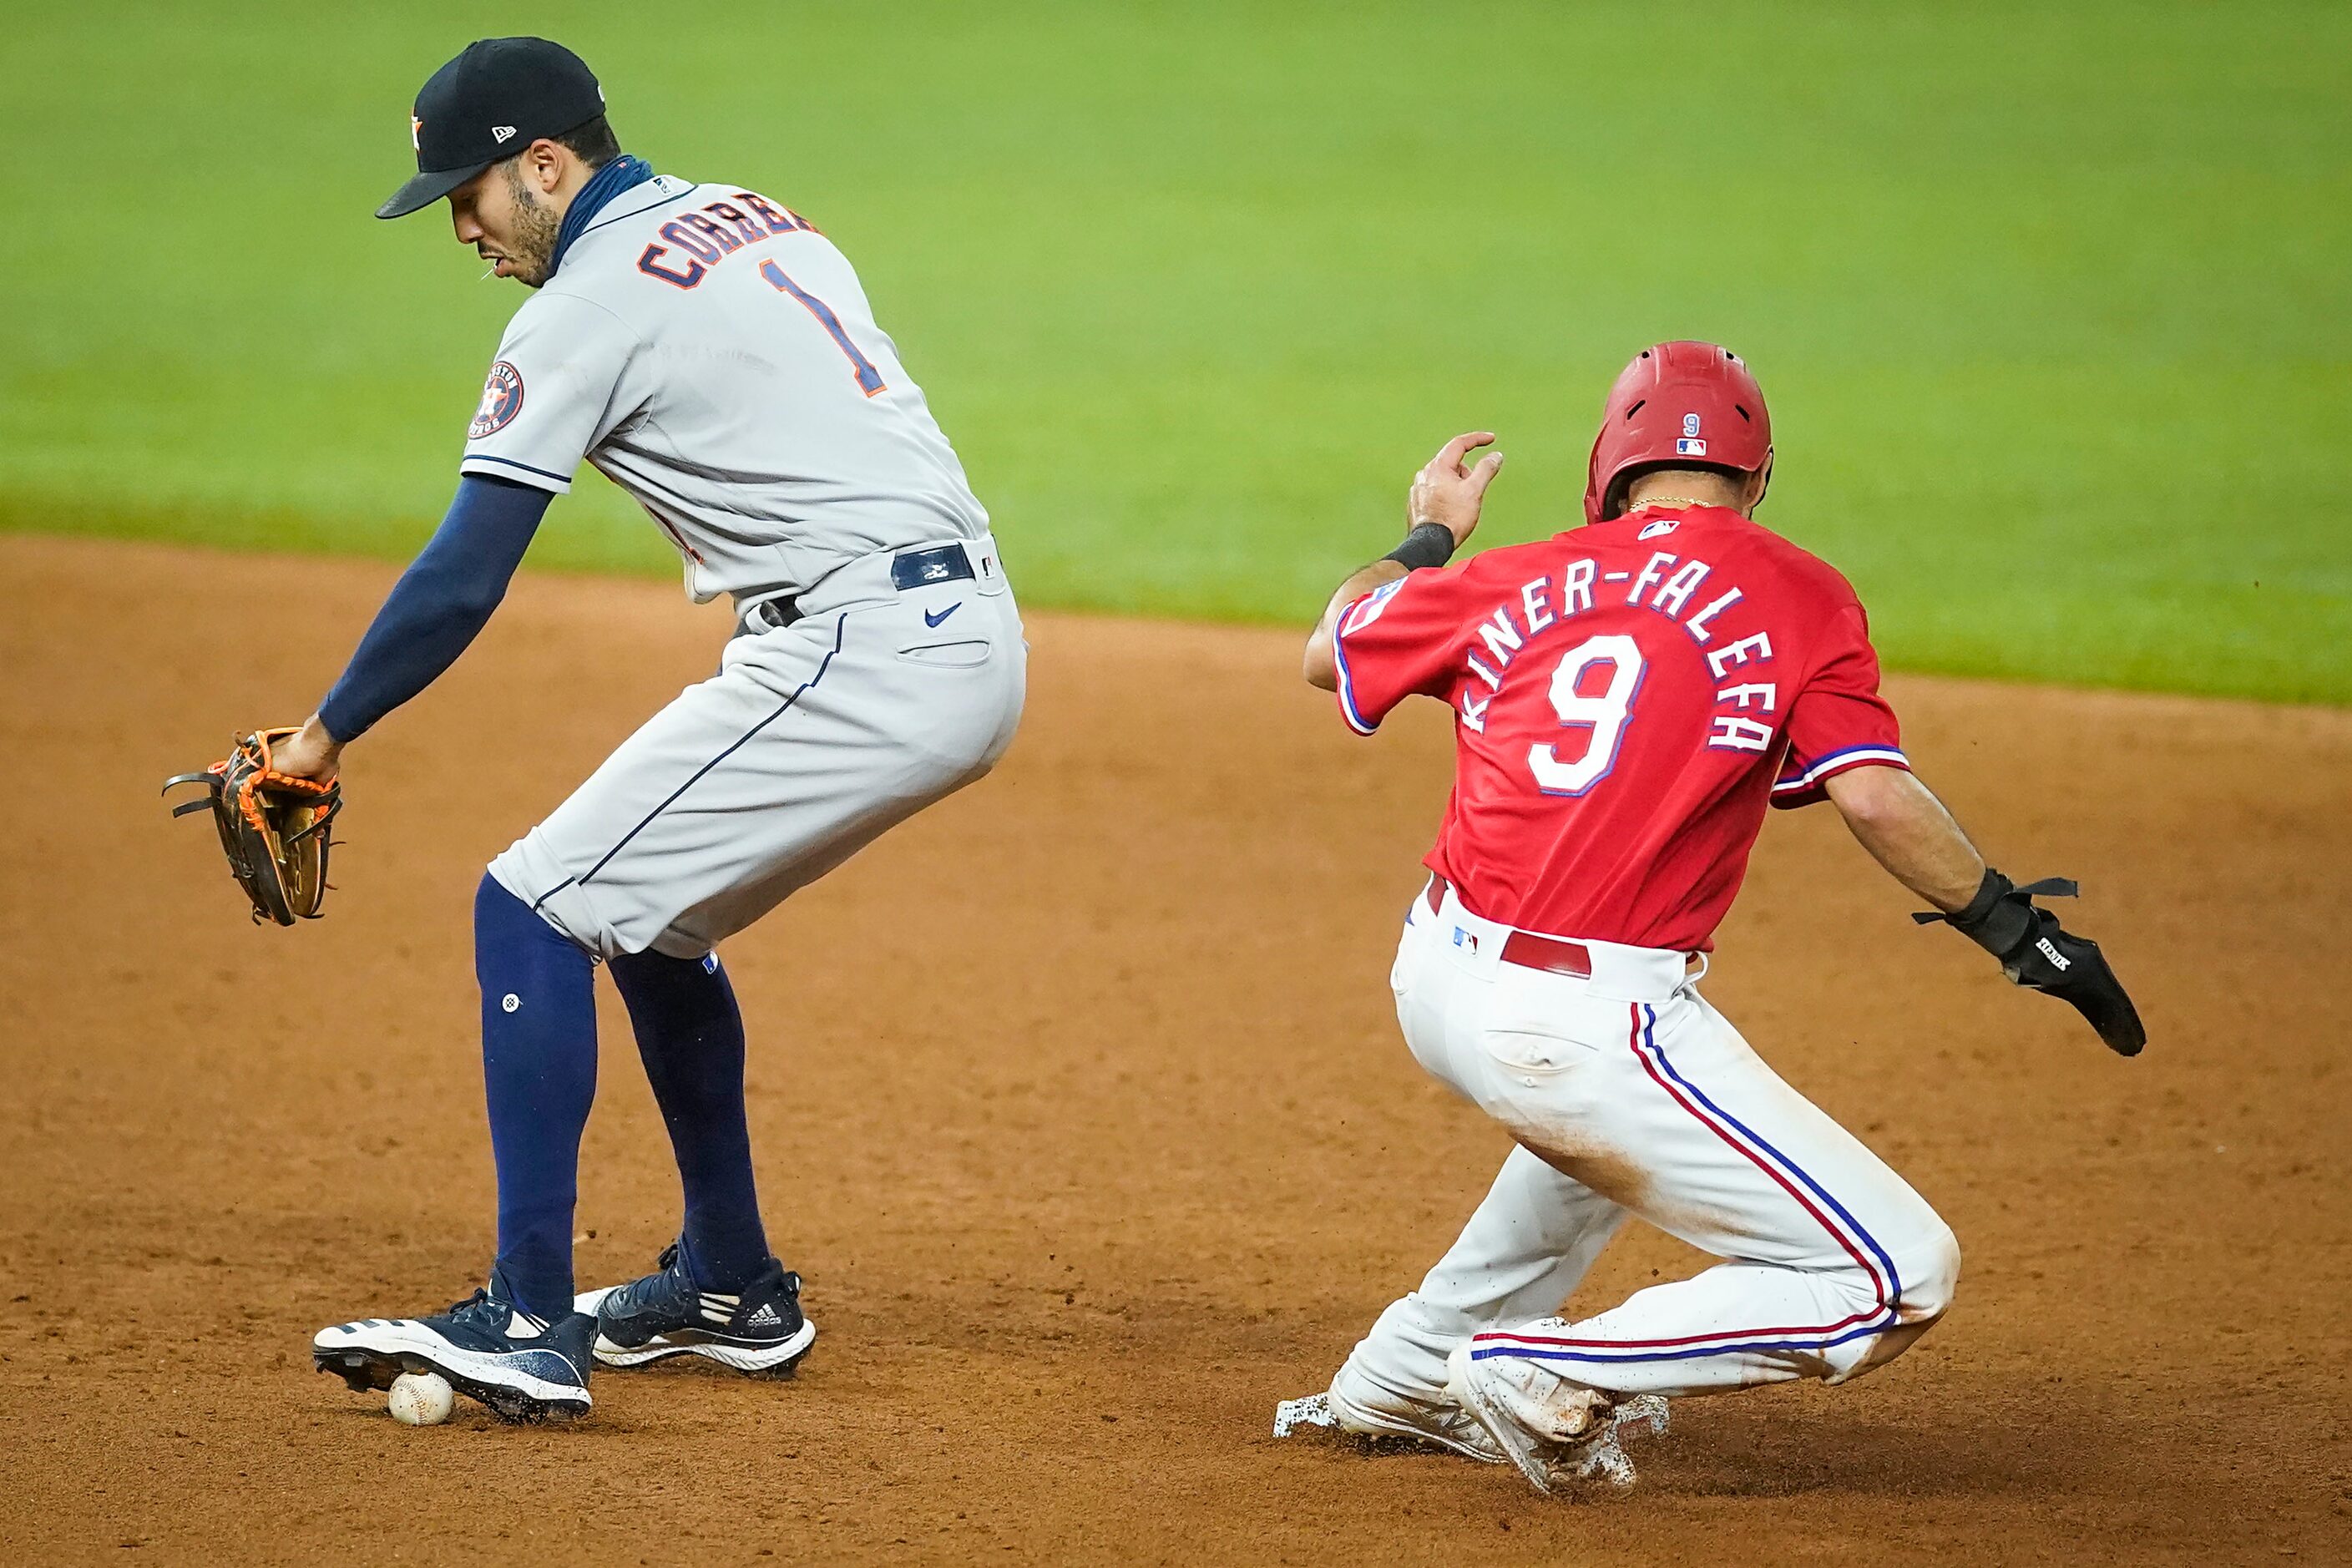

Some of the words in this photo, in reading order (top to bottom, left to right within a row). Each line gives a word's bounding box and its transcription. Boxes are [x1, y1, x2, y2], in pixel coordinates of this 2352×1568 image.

[758, 258, 888, 398] 1
[1682, 412, 1702, 438] 9
[1461, 550, 1777, 754] KINER-FALEFA
[1526, 634, 1648, 797] 9
